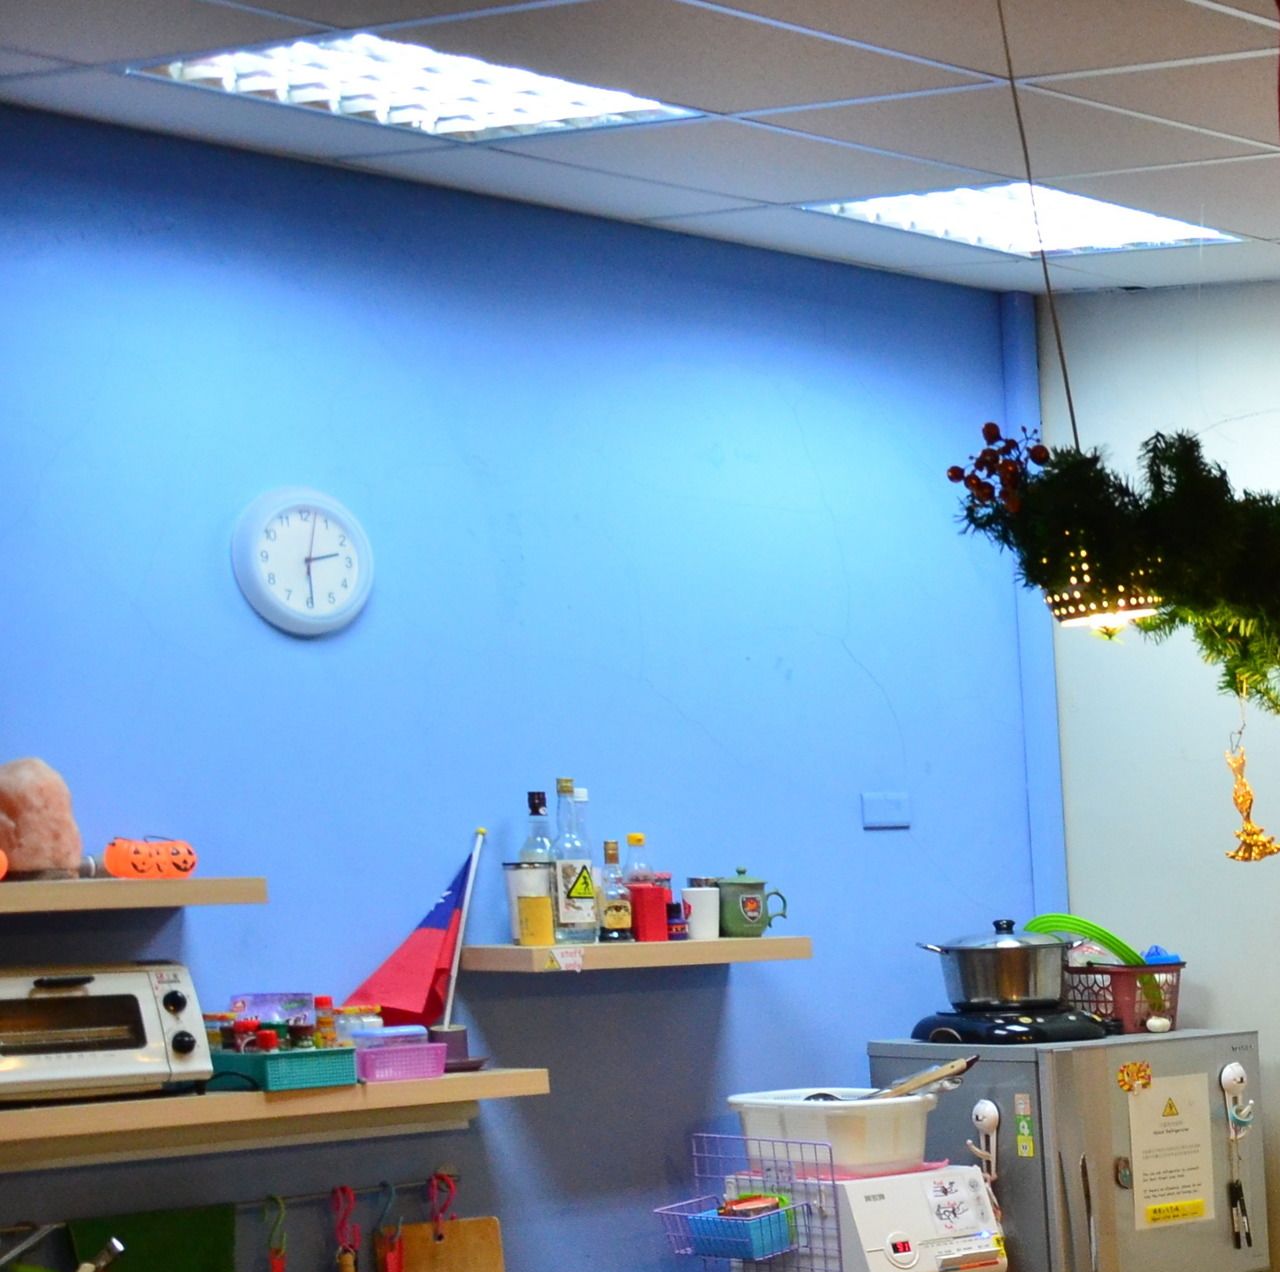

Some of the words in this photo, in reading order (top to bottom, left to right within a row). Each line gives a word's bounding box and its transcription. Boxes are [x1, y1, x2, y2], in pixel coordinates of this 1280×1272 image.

[279, 515, 290, 527] 11
[298, 510, 310, 521] 12
[264, 529, 277, 541] 10
[338, 536, 345, 547] 2
[260, 551, 269, 562] 9
[345, 557, 352, 568] 3
[267, 573, 276, 585] 8
[341, 579, 348, 590] 4
[285, 589, 293, 600] 7
[328, 593, 336, 604] 5
